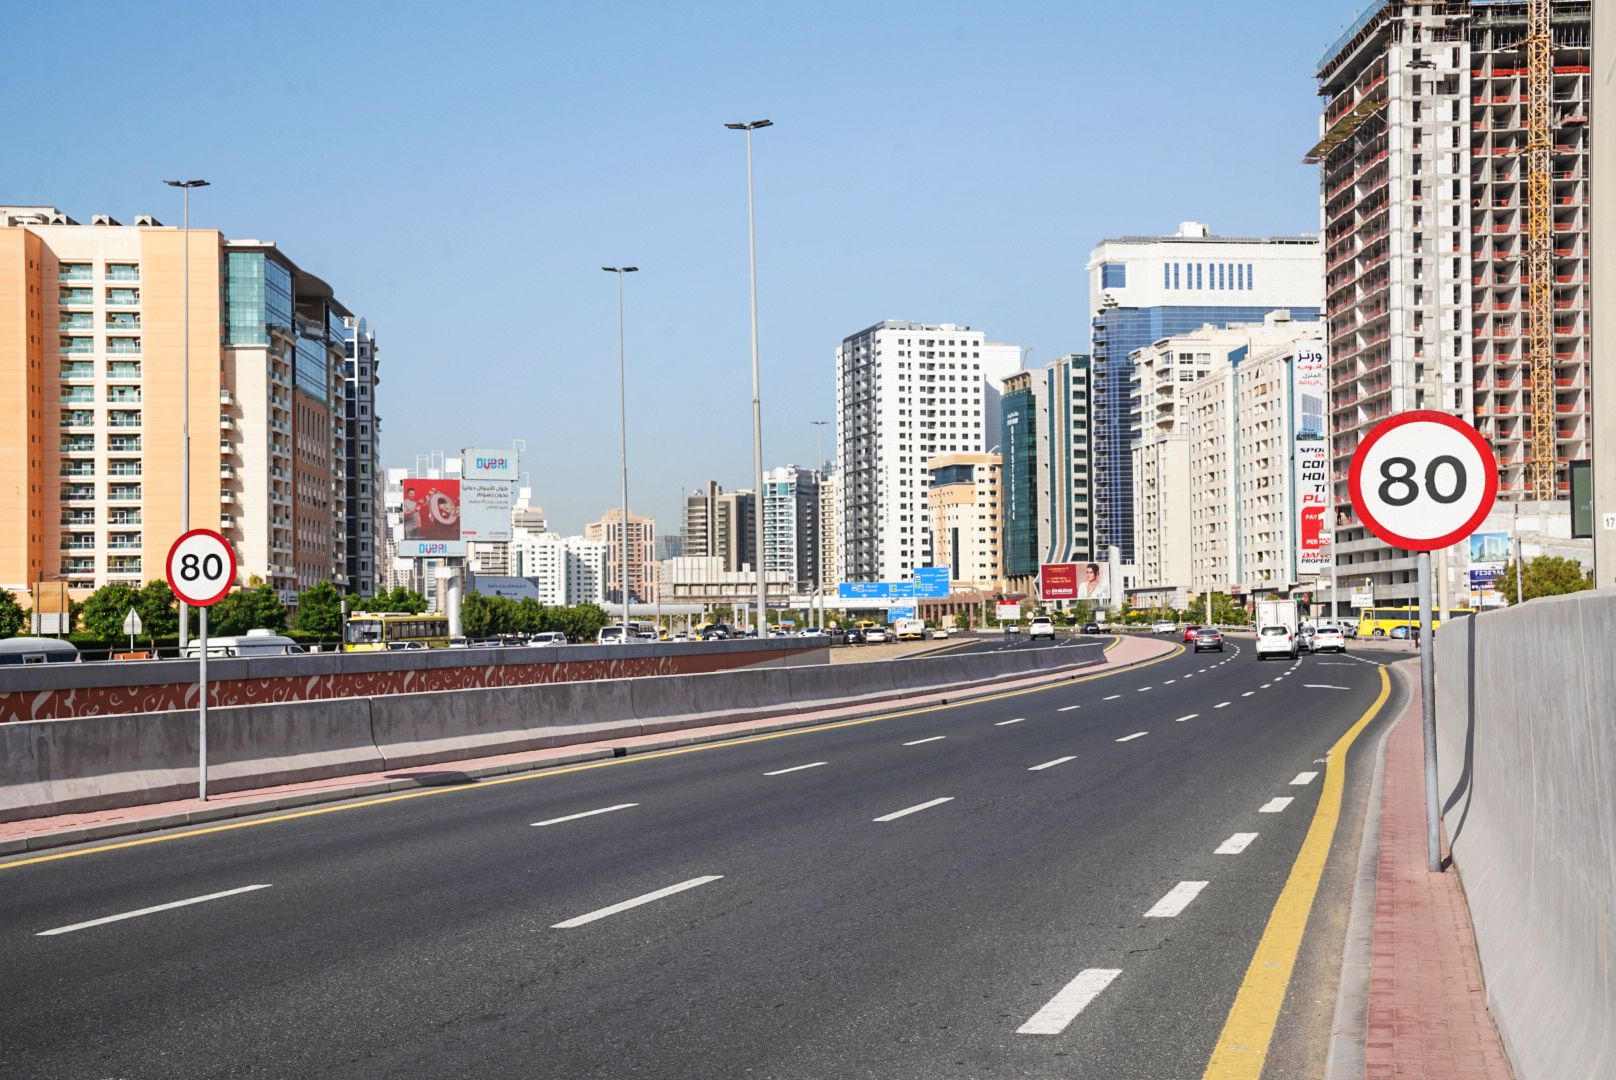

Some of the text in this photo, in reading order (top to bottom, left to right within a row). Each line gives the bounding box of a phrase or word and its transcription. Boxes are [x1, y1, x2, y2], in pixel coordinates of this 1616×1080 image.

[1298, 349, 1322, 362] ورتز
[476, 458, 508, 470] DUBAI
[1378, 454, 1467, 507] 80
[1303, 494, 1325, 503] PL
[1605, 517, 1616, 528] 17
[418, 543, 447, 554] DUBAI
[180, 553, 223, 581] 80
